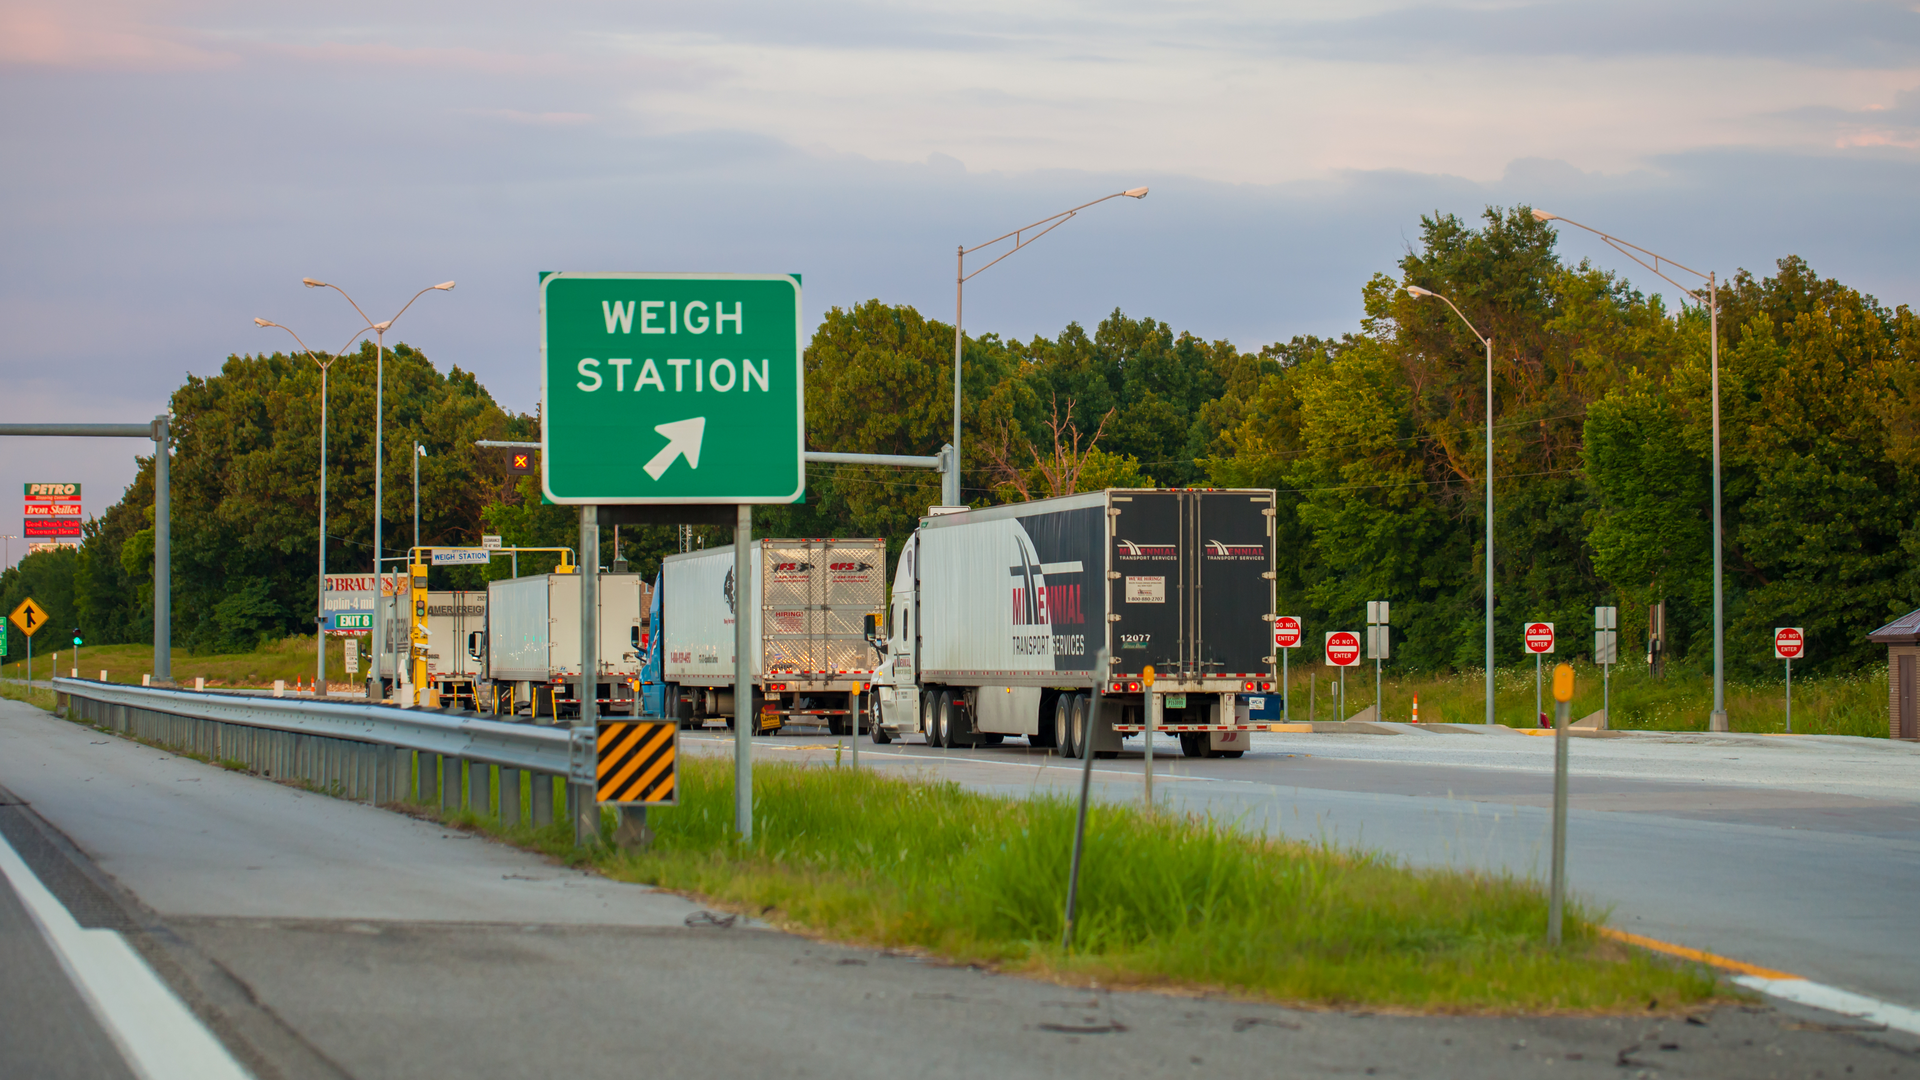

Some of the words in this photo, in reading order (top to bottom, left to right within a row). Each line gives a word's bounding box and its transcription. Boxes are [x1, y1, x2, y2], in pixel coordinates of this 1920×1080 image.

[602, 300, 742, 335] WEIGH
[576, 358, 769, 392] STATION
[30, 484, 76, 495] PETRO
[27, 505, 48, 514] Iron
[49, 505, 79, 514] Skillet
[458, 552, 487, 560] STATION
[340, 615, 361, 627] EXIT
[362, 615, 370, 627] 8
[1120, 634, 1151, 642] 12077
[1012, 635, 1050, 655] TRANSPORT
[1052, 634, 1085, 655] SERVICES
